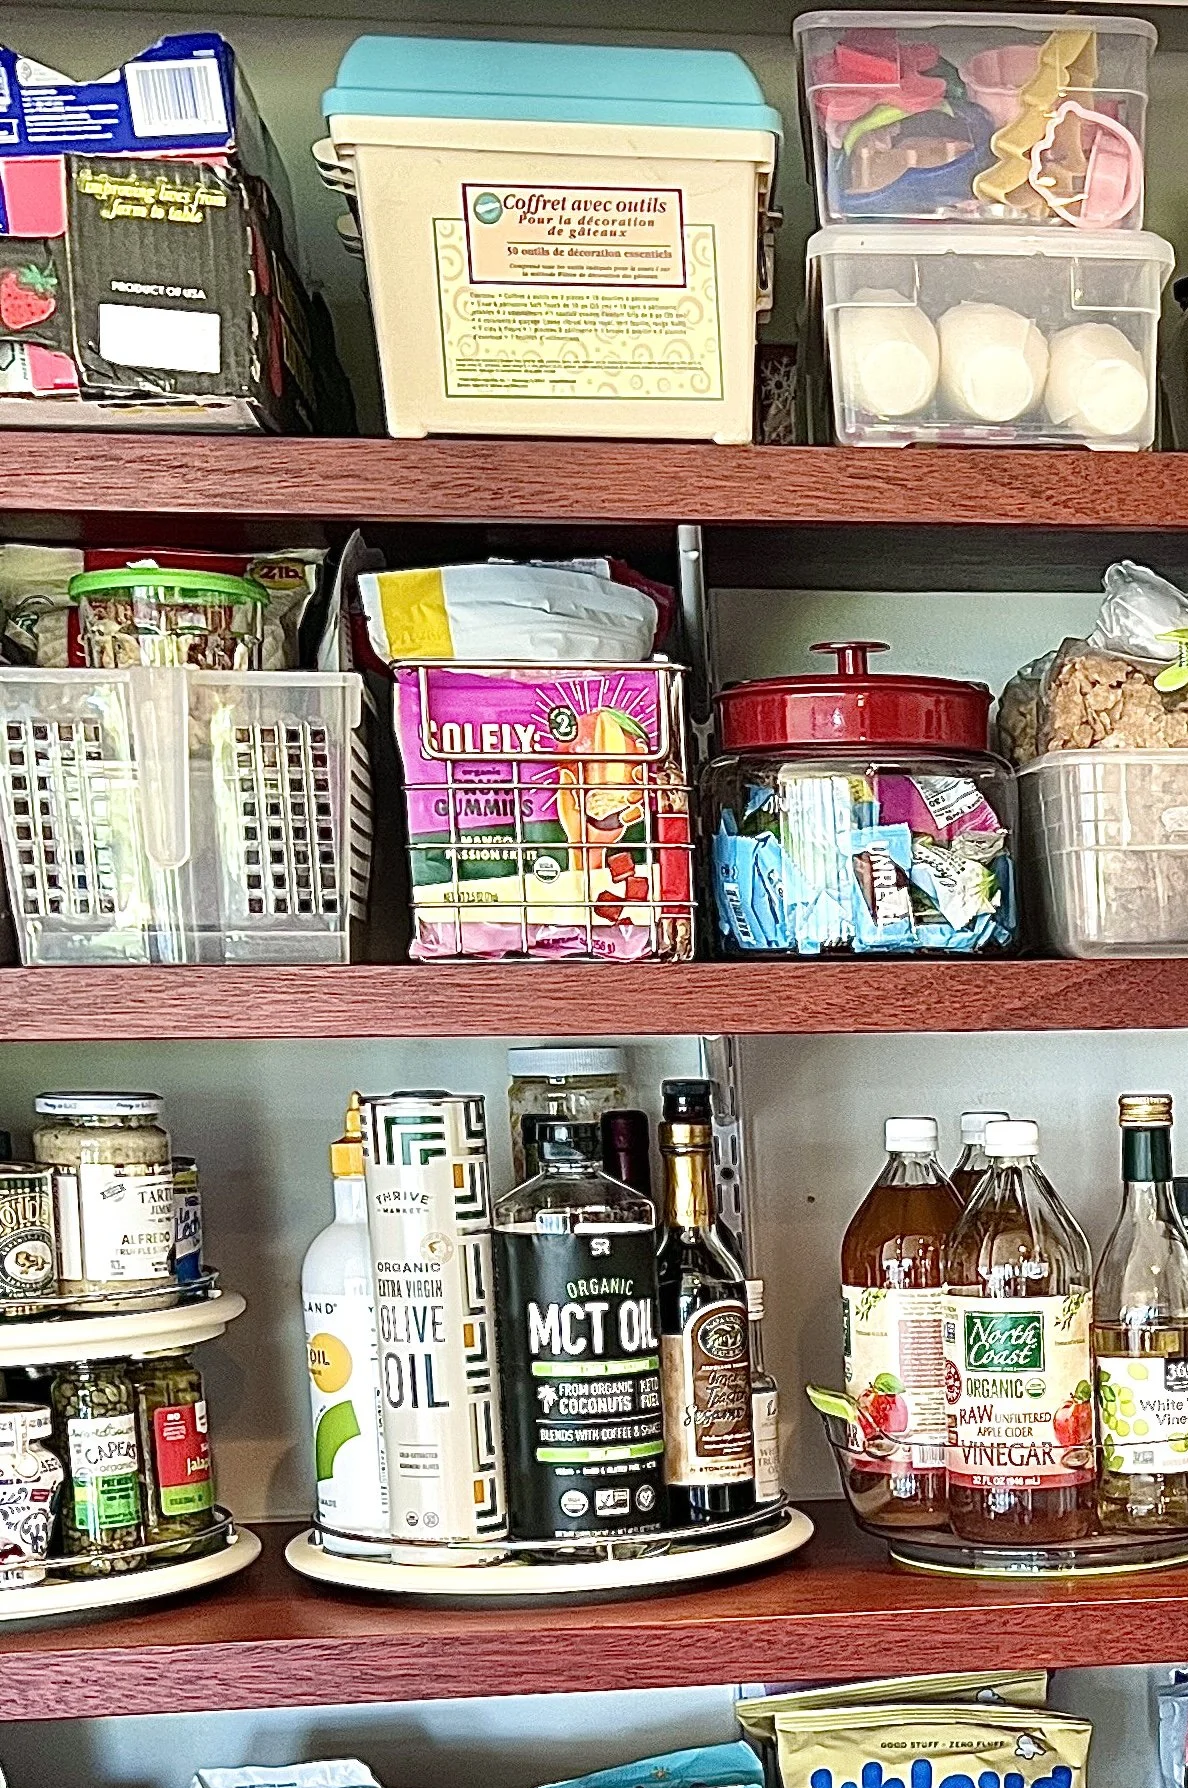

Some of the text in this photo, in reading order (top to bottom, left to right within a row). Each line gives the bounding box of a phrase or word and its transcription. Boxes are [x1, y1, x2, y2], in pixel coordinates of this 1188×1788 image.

[503, 193, 667, 215] Coffret avec outils
[519, 215, 655, 227] Pour la décoration
[548, 226, 626, 238] de gâteaux
[507, 247, 518, 255] 50
[521, 247, 550, 256] outils
[553, 248, 564, 256] de
[112, 281, 206, 299] PRODUCT OF USA
[557, 715, 569, 733] 2
[462, 767, 501, 776] organic
[375, 1191, 429, 1204] THRIVE
[121, 1232, 170, 1244] ALFREDO
[377, 1261, 441, 1273] ORGANIC
[378, 1278, 442, 1298] EXTRA VIRGIN
[566, 1279, 634, 1299] ORGANIC
[380, 1304, 446, 1343] OLIVE
[528, 1301, 609, 1356] MCT
[619, 1298, 659, 1351] OIL
[970, 1319, 1040, 1345] North
[969, 1343, 1032, 1366] Coast
[385, 1352, 449, 1409] OIL
[559, 1379, 633, 1396] FROM ORGANIC
[966, 1378, 1024, 1399] ORGANIC
[558, 1396, 631, 1415] COCONUTS
[1140, 1399, 1184, 1411] White
[959, 1404, 1051, 1425] RAW UNFILTERED
[540, 1423, 639, 1442] BLENDS WITH COFFEE &
[977, 1426, 1033, 1438] APPLE CIDER
[962, 1440, 1055, 1467] VINEGAR
[880, 1740, 1005, 1749] GOOD STUFF ZERO FLUFF
